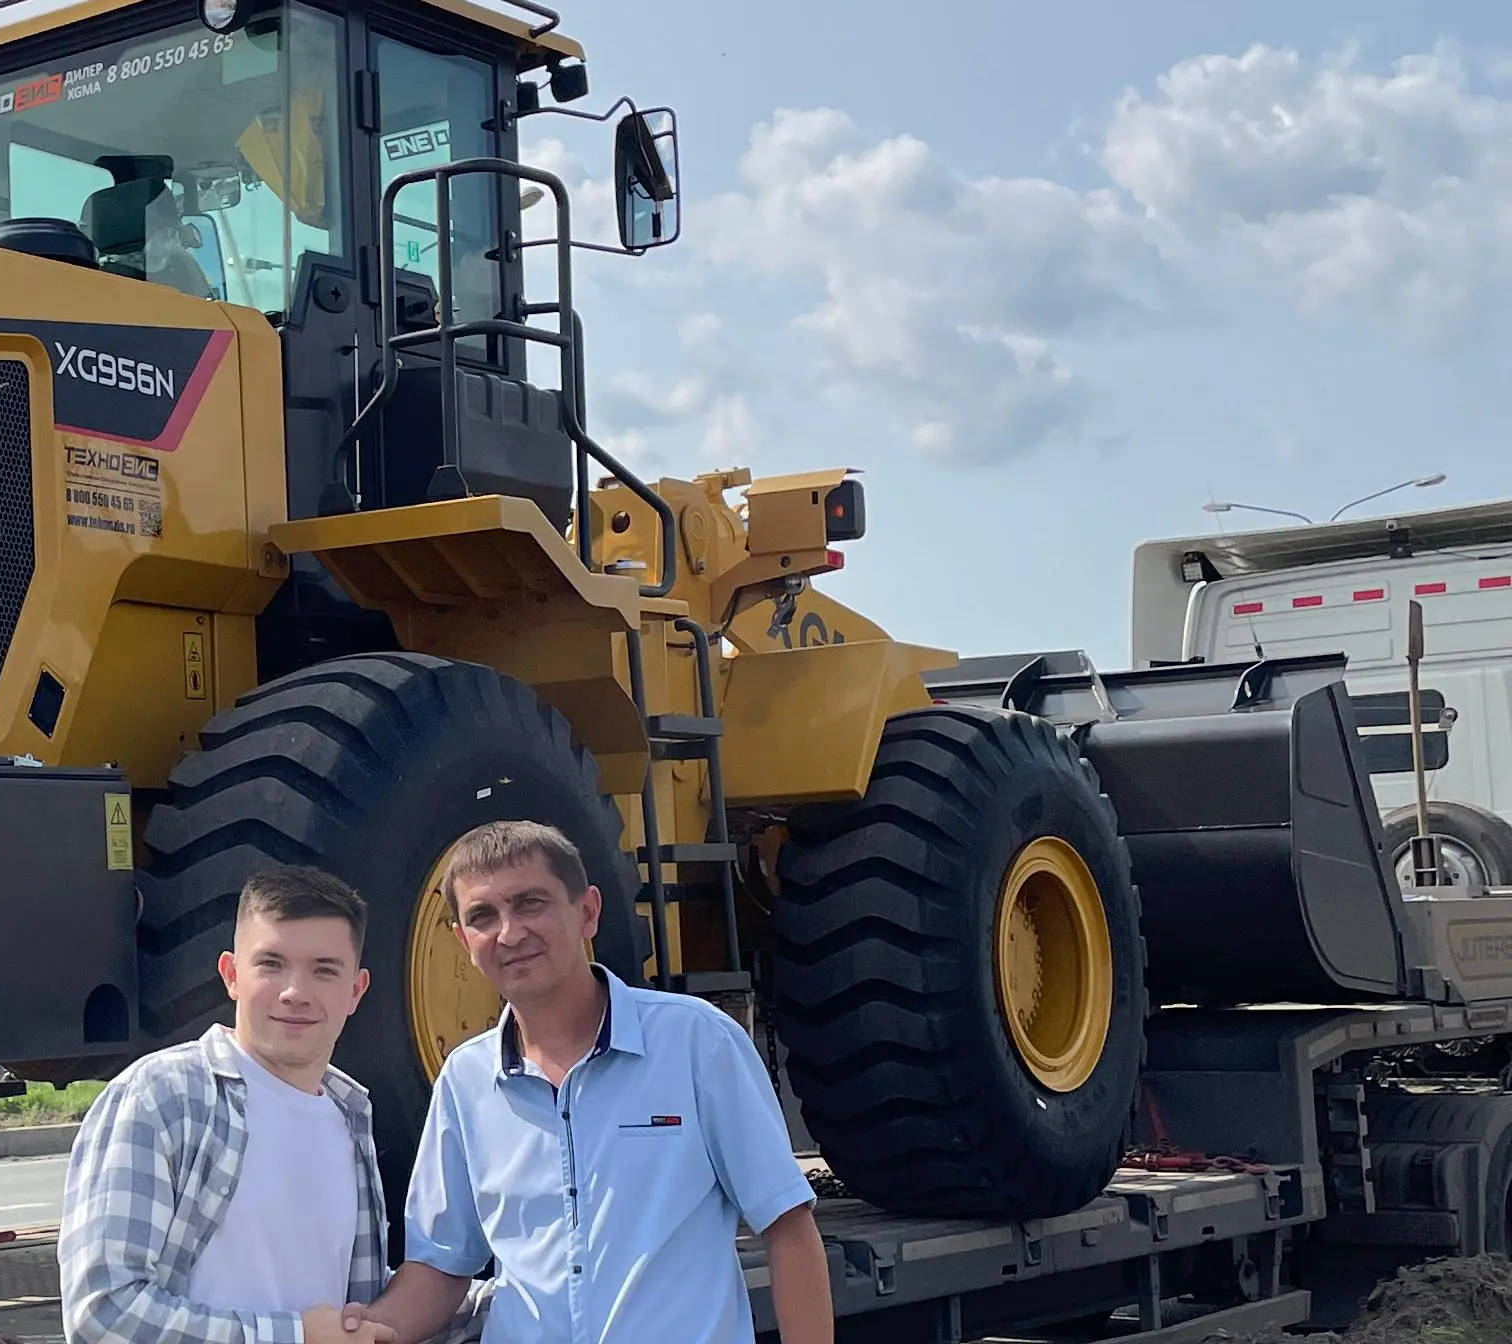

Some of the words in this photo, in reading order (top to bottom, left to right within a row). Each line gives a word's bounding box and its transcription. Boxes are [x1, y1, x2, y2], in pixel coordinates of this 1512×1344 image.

[107, 65, 117, 84] 8
[121, 56, 151, 80] 800
[154, 46, 185, 71] 550
[189, 39, 209, 61] 45
[213, 33, 234, 54] 65
[64, 63, 104, 86] ДИЛЕР
[67, 81, 102, 101] XGMA
[55, 341, 174, 399] XG956N
[66, 488, 72, 502] 8
[73, 489, 90, 504] 800
[92, 492, 109, 508] 550
[110, 496, 121, 510] 45
[123, 497, 134, 511] 65
